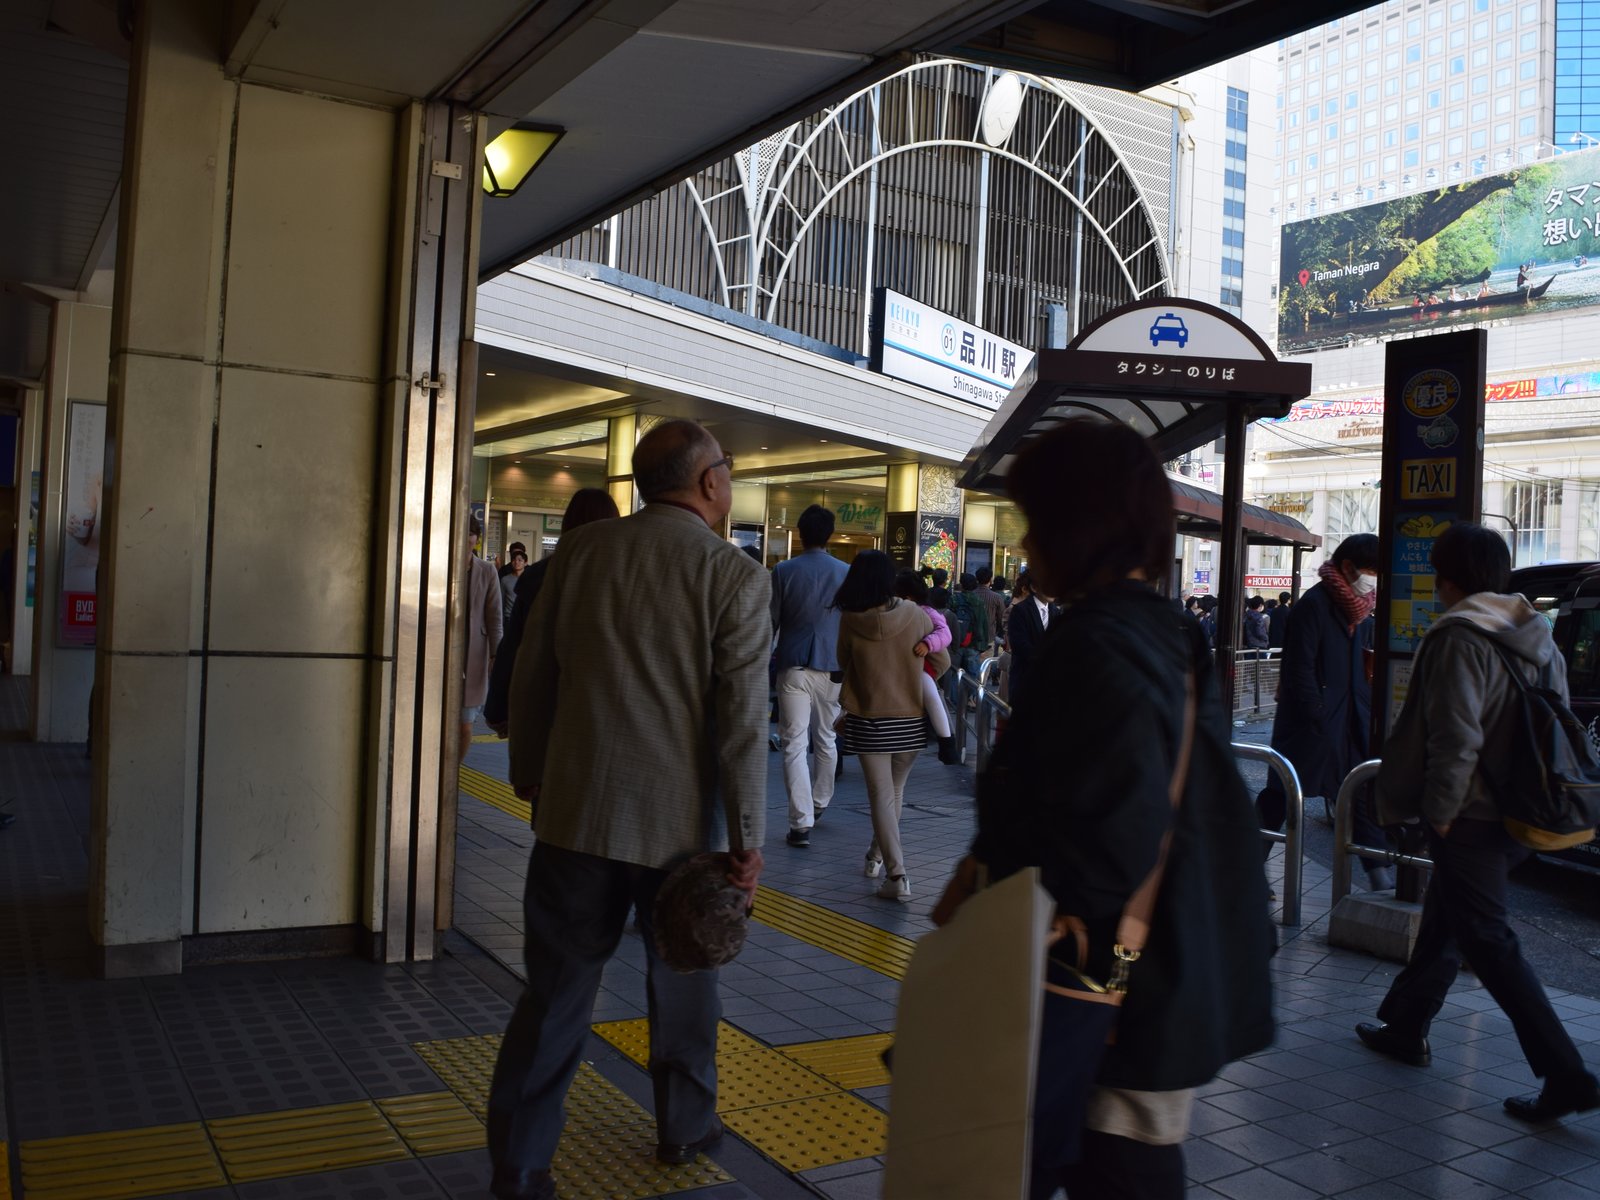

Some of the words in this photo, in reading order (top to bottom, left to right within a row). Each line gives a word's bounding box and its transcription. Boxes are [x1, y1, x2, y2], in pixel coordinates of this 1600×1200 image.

[1543, 212, 1600, 247] 想い
[1313, 269, 1343, 281] Taman
[1344, 261, 1380, 277] Negara
[890, 303, 920, 328] KEIKYU
[943, 336, 953, 352] 01
[960, 331, 1016, 380] 品川駅
[1117, 361, 1235, 382] タクシーのりば
[953, 376, 993, 401] Shinagawa
[1413, 384, 1448, 409] 優良
[1406, 463, 1451, 493] TAXI
[837, 503, 881, 528] Wing
[921, 519, 944, 537] Wing
[1252, 577, 1292, 587] HOLLYWOOD
